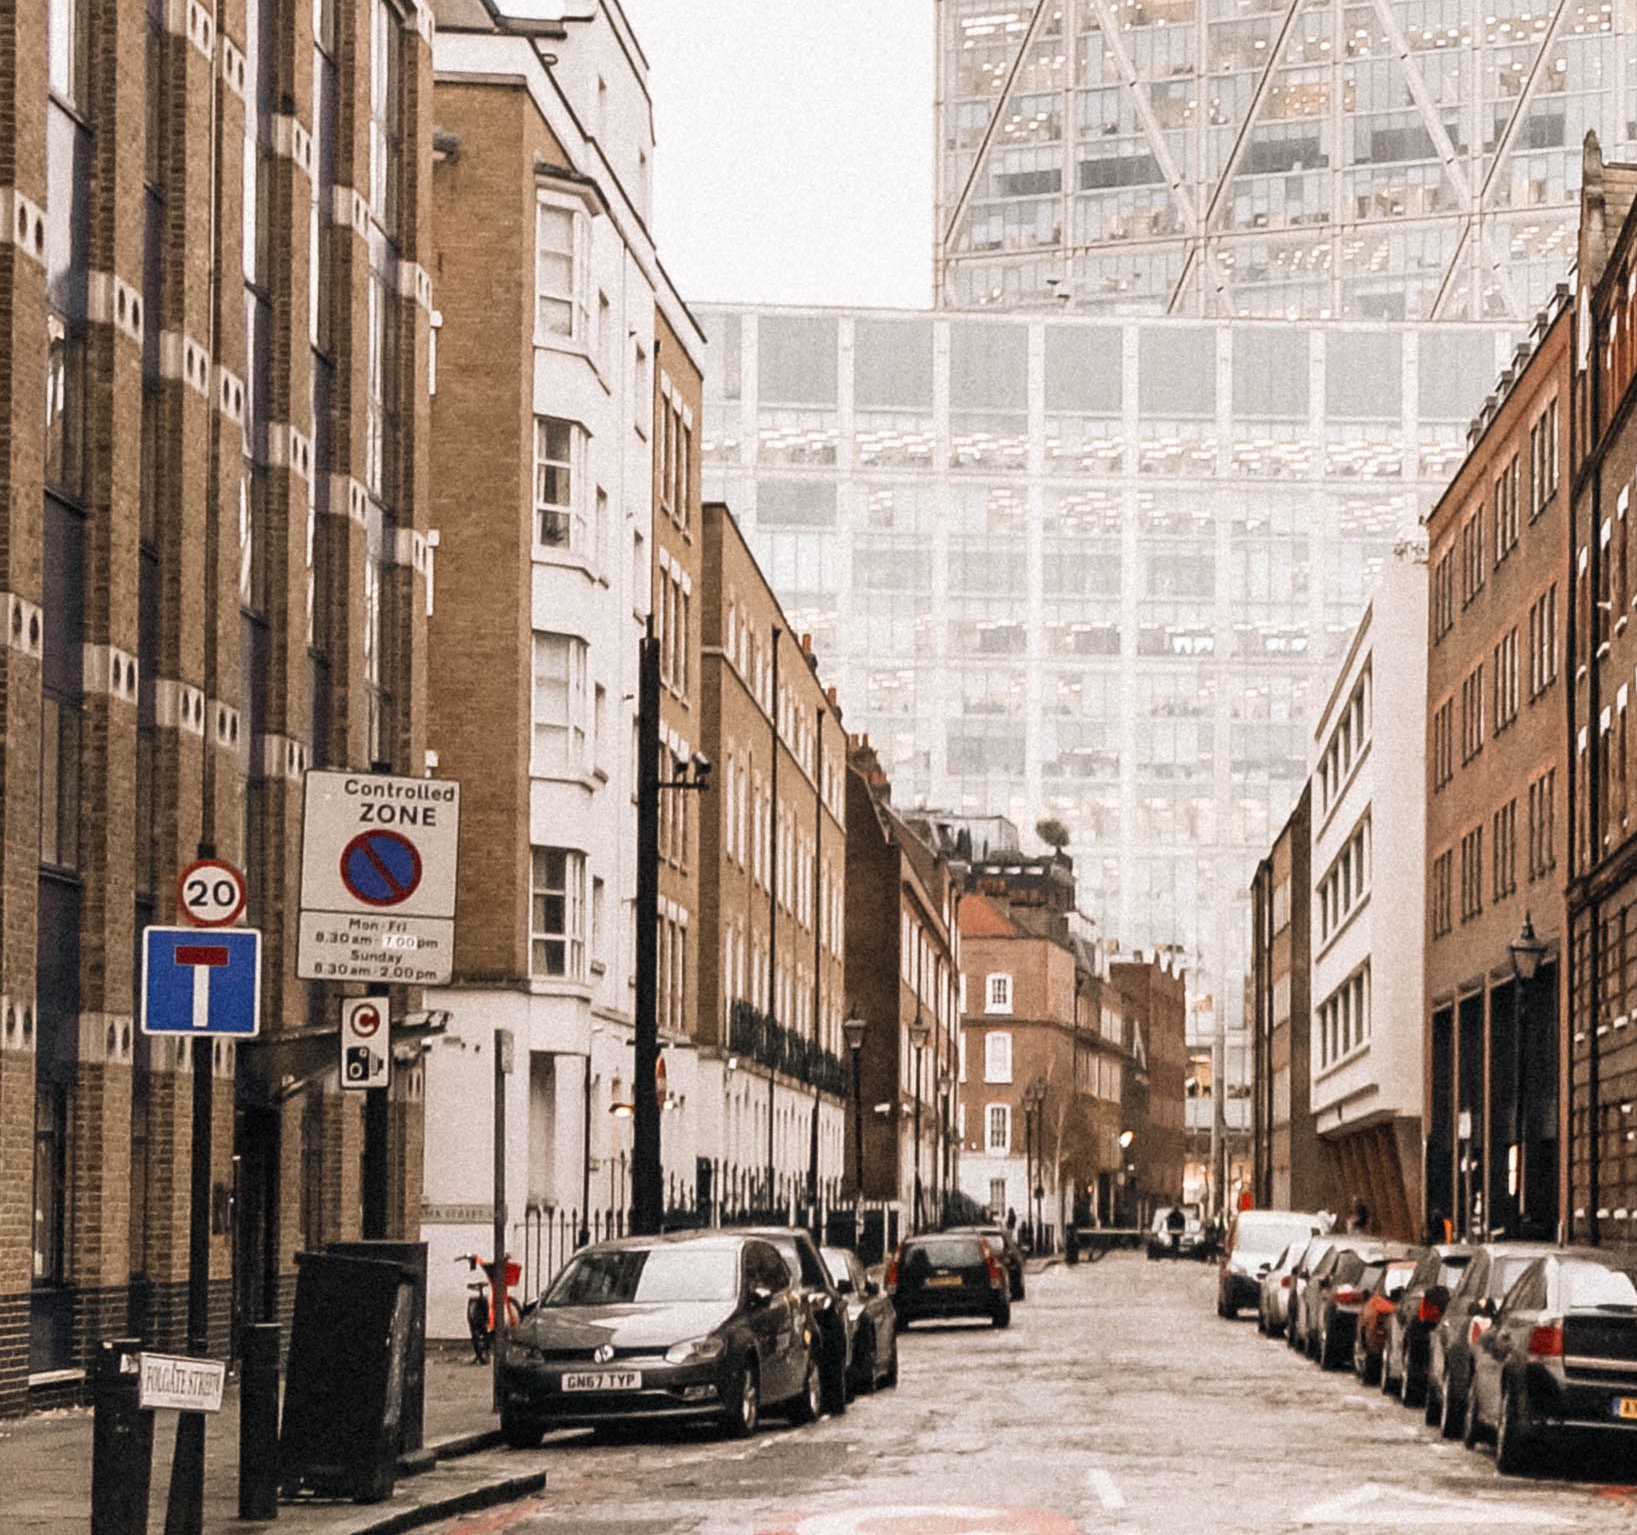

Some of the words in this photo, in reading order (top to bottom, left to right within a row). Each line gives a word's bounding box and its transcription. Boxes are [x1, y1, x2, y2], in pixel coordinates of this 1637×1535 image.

[344, 779, 455, 802] Controlled
[359, 803, 437, 827] ZONE
[187, 880, 236, 907] 20
[348, 918, 379, 931] Mon
[388, 920, 408, 933] Fri
[350, 949, 404, 965] Sunday
